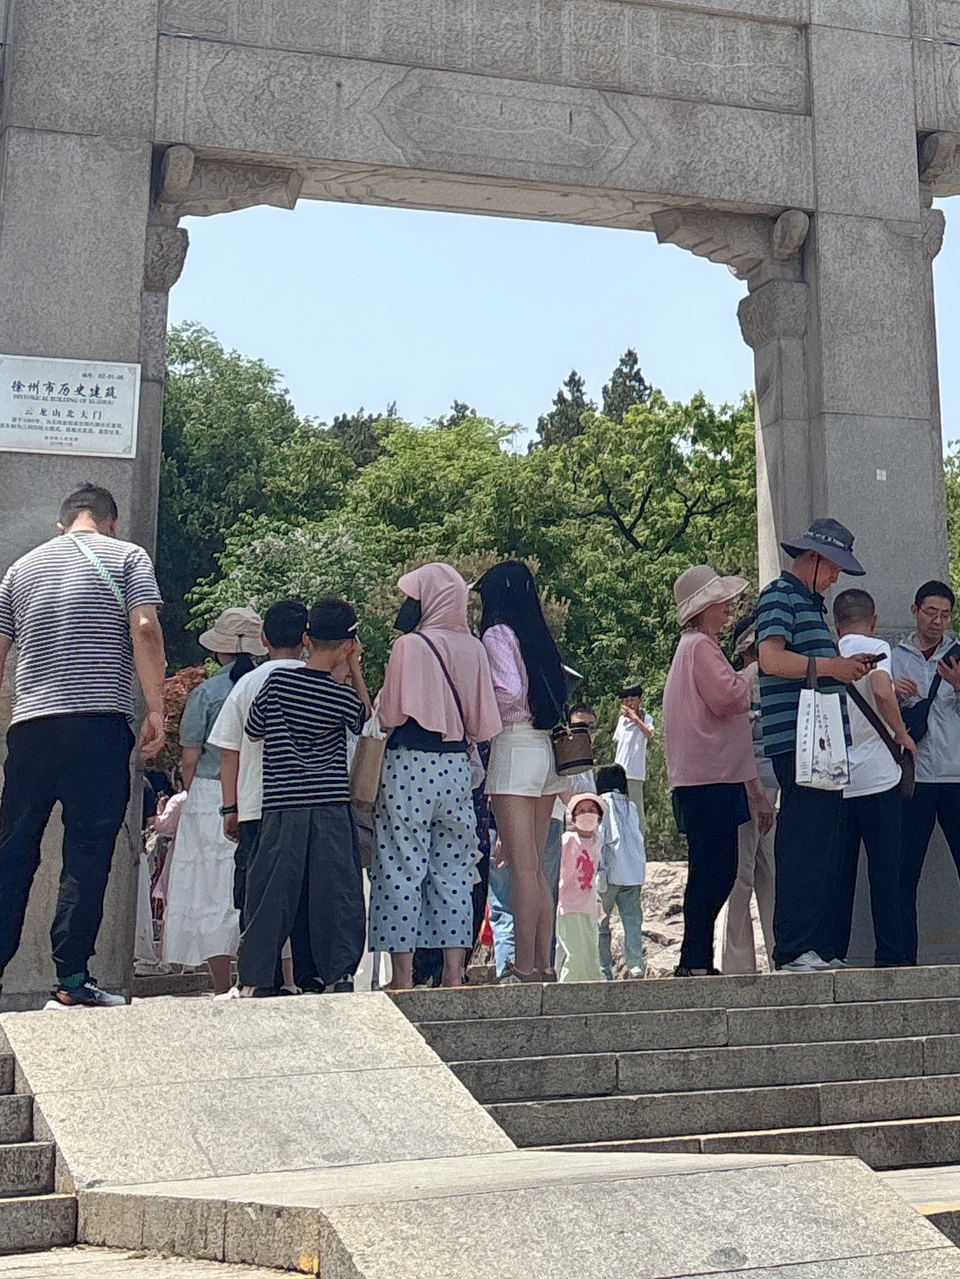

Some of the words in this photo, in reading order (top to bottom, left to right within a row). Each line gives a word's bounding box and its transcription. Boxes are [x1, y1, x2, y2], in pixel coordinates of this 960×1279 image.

[11, 379, 117, 399] 徐州市历史建筑
[24, 406, 102, 420] 云龙山北大门
